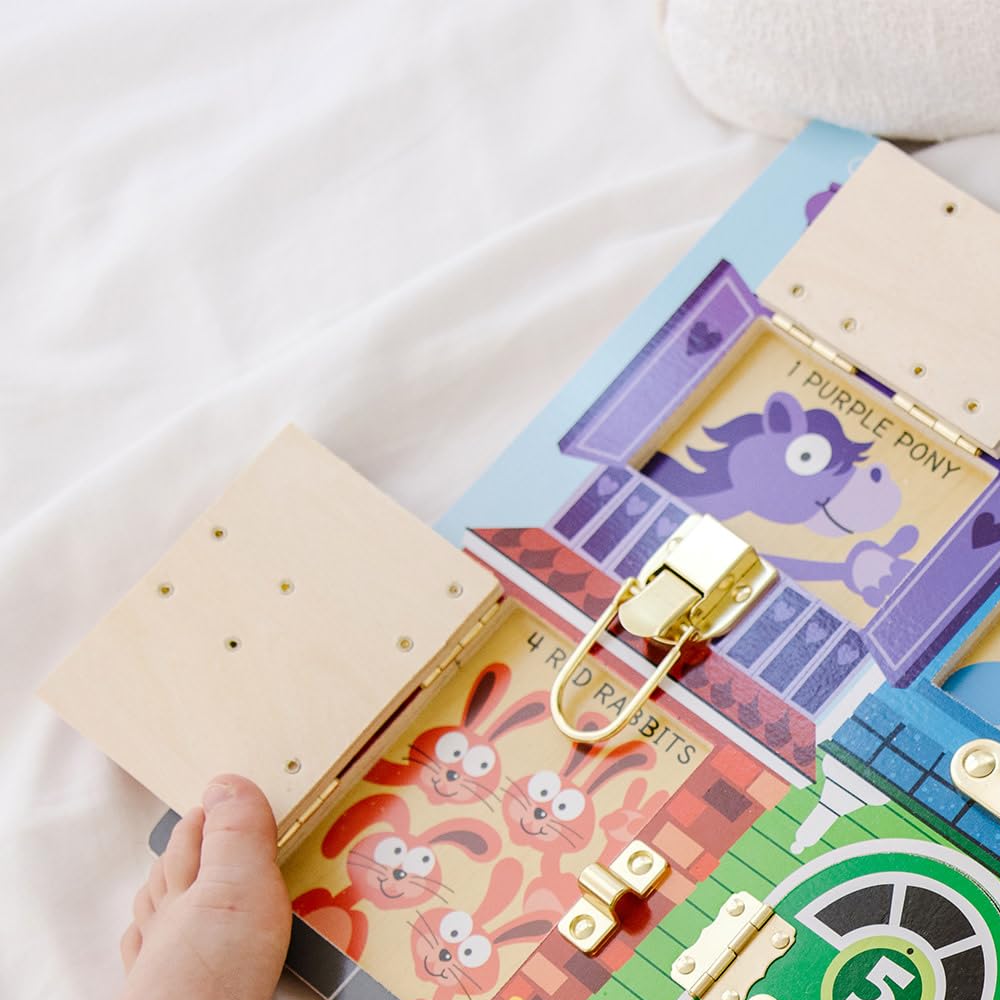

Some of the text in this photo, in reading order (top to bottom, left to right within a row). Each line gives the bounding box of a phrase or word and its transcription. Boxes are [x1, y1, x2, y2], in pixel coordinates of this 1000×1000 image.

[787, 360, 961, 479] 1 PURPLE PONY
[527, 631, 544, 652] 4
[545, 647, 593, 687] RD
